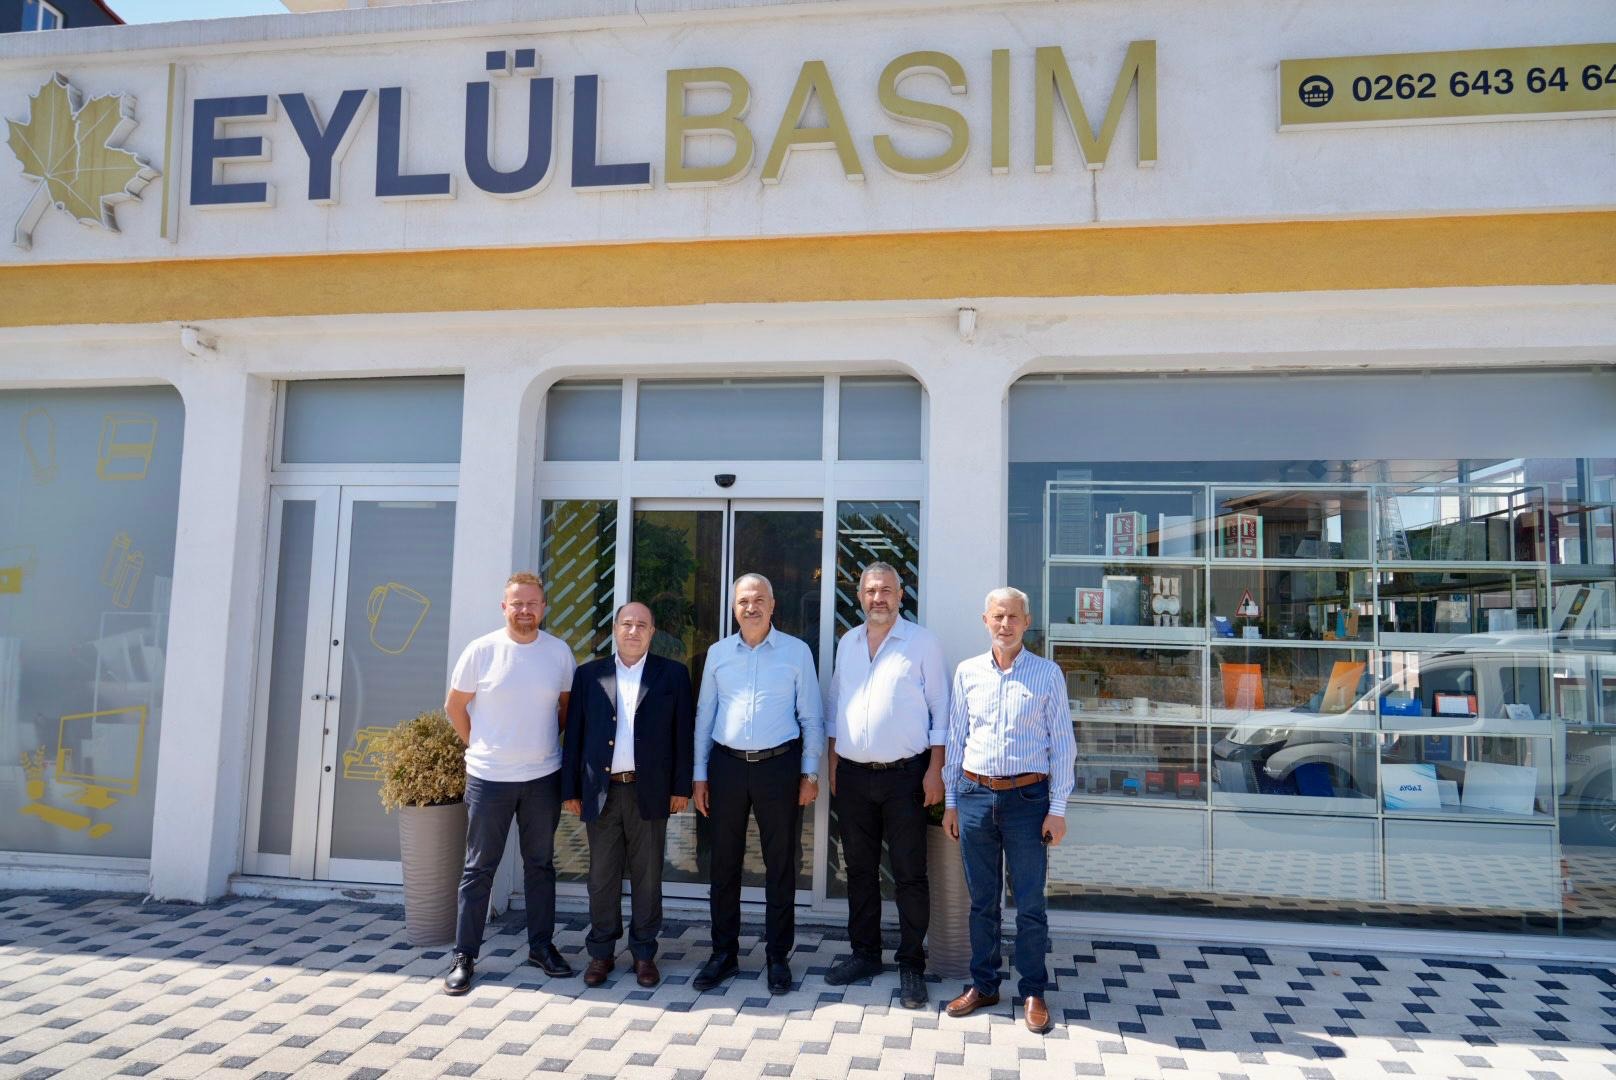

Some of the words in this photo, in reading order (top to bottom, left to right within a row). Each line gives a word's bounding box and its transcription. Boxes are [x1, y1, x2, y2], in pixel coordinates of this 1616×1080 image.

[1352, 73, 1437, 102] 0262
[1449, 68, 1514, 98] 643
[1526, 66, 1569, 94] 64
